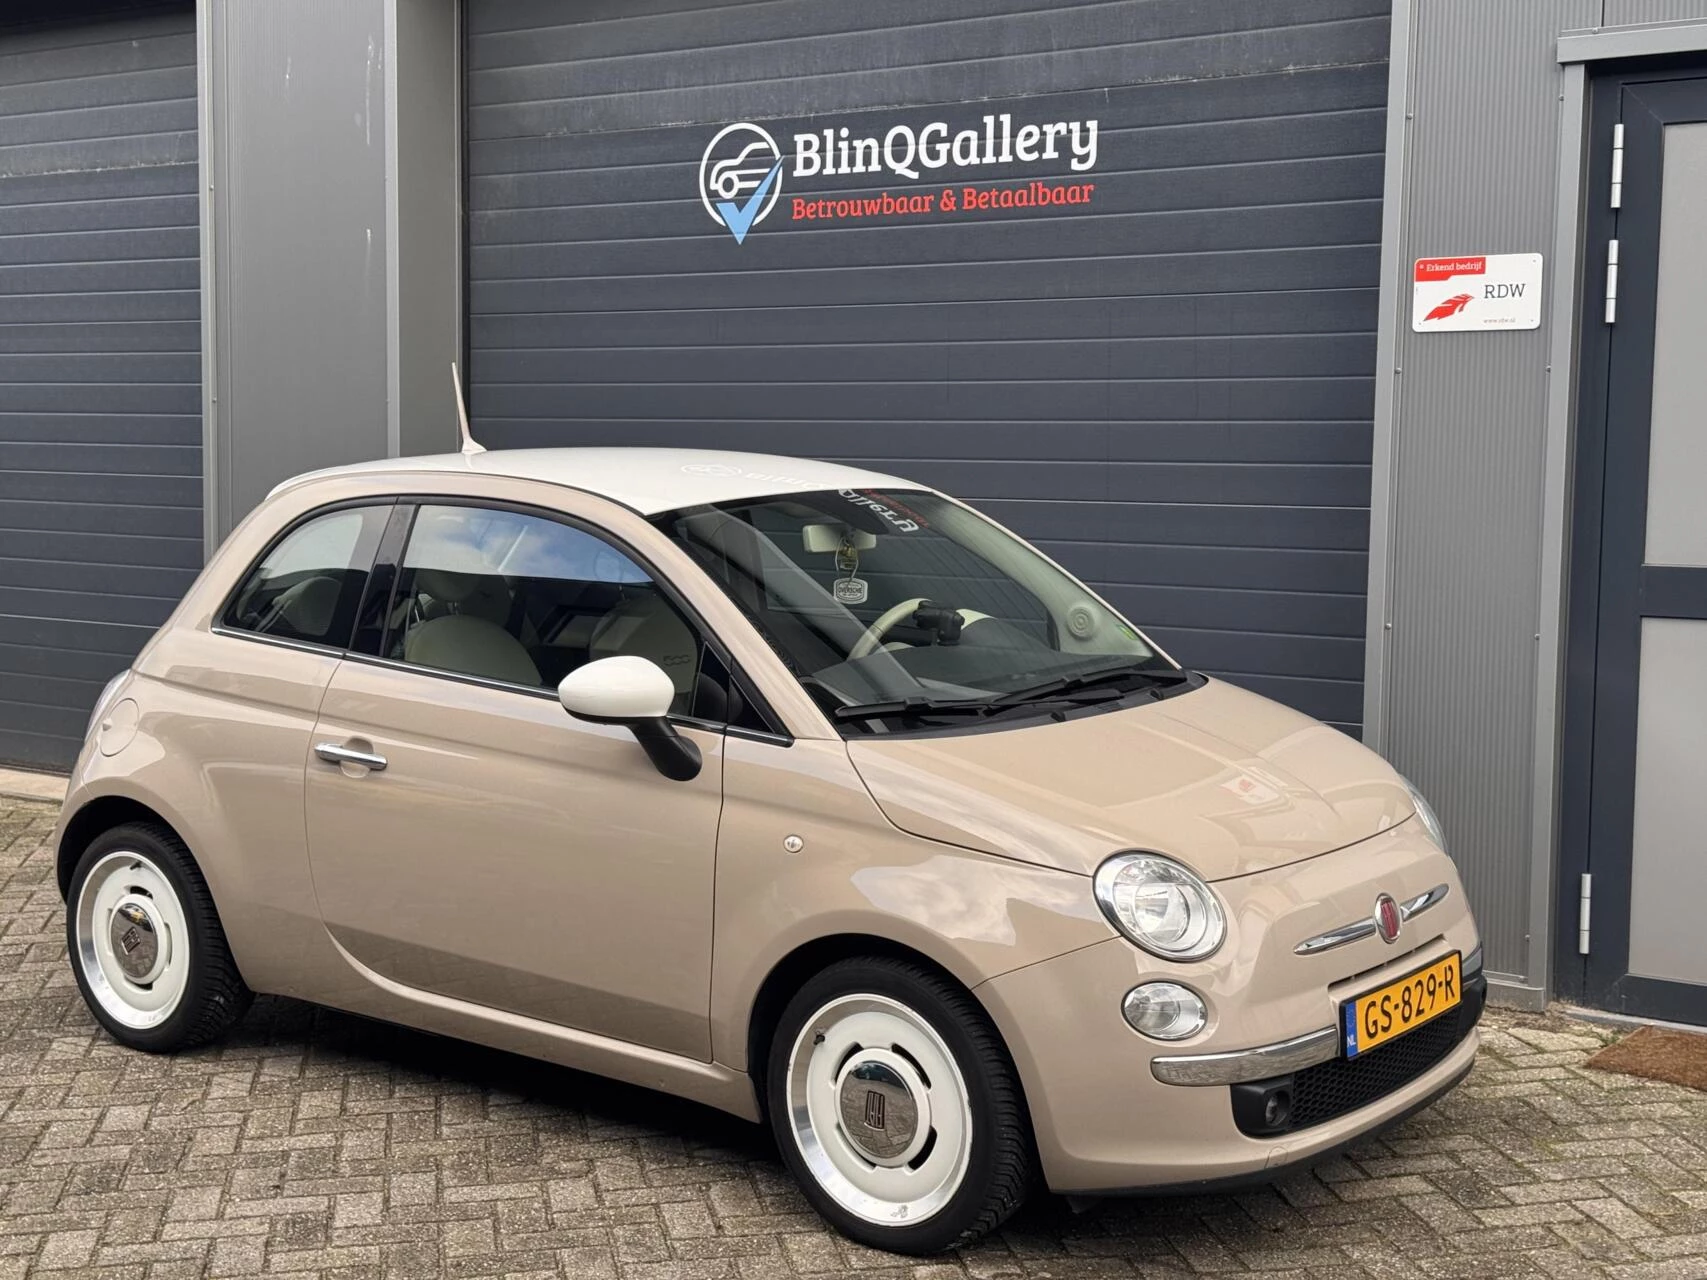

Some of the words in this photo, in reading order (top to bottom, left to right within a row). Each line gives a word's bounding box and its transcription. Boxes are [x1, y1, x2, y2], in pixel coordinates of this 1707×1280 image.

[793, 113, 1099, 179] BlinQGallery
[792, 191, 935, 220] Betrouwbaar
[939, 189, 957, 212] &
[961, 182, 1095, 210] Betaalbaar
[1426, 262, 1455, 272] Erkend
[1455, 260, 1483, 272] bedrijf
[1484, 283, 1526, 299] RDW
[1364, 964, 1456, 1039] GS-829-R
[1346, 1034, 1357, 1048] NL
